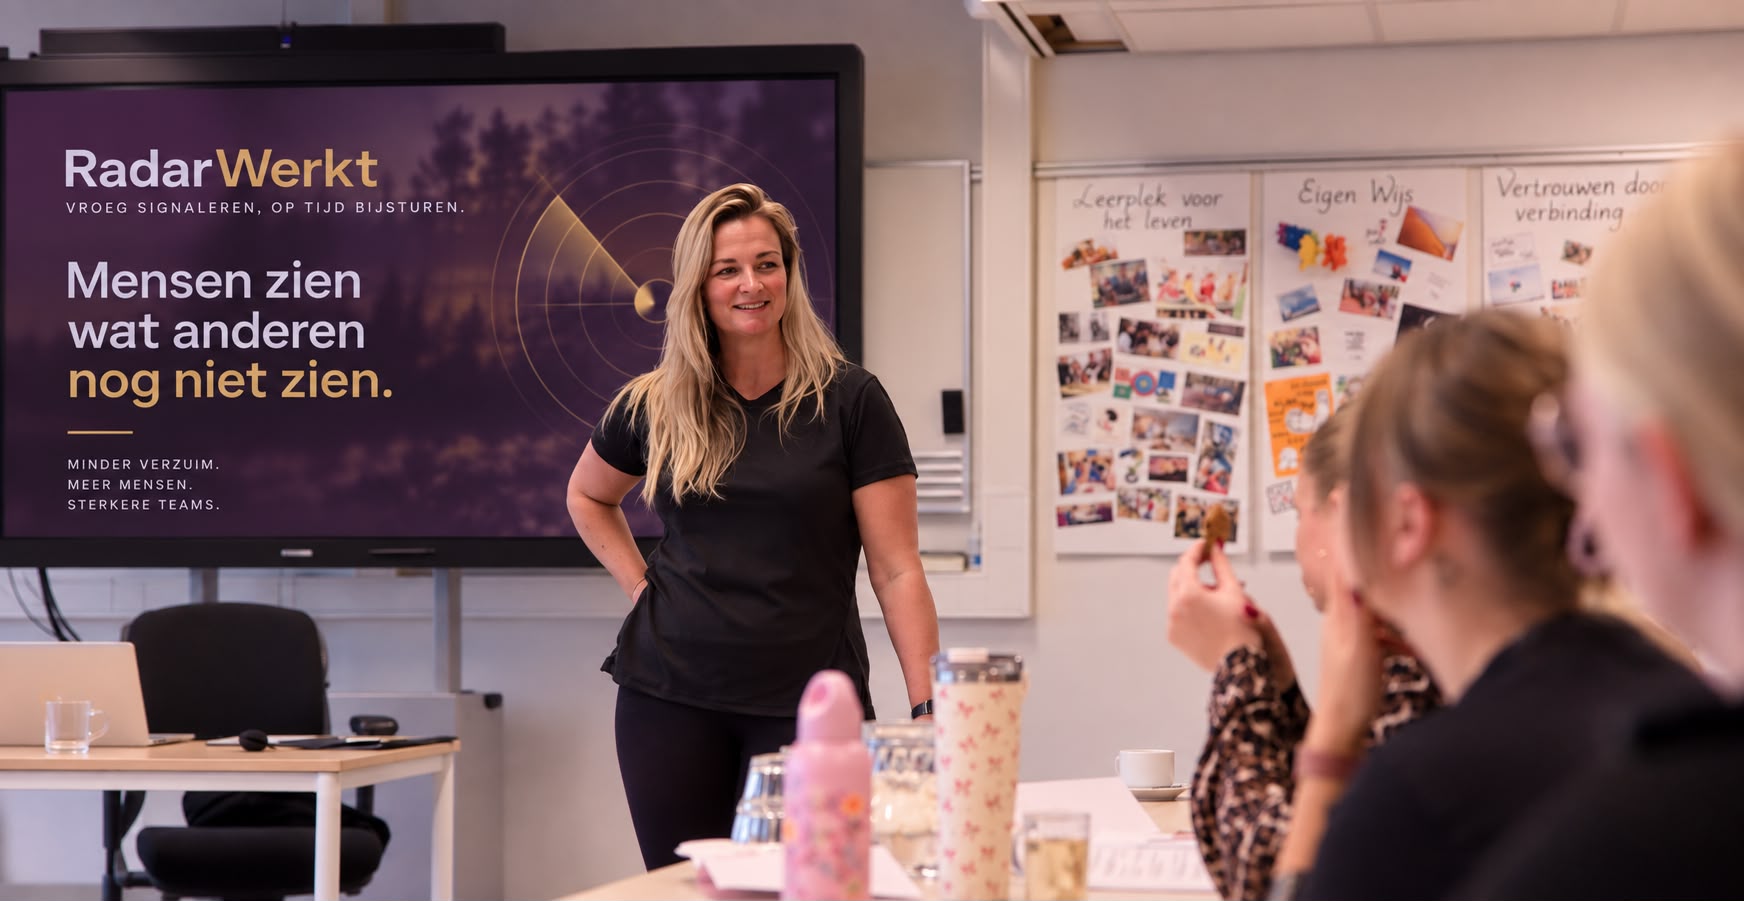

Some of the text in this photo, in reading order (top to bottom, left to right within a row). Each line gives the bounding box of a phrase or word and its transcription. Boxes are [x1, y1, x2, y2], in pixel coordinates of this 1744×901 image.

[65, 148, 378, 188] RadarWerkt
[1497, 167, 1615, 197] Vertrouwen
[66, 201, 465, 216] VROEG SIGNALEREN, OP TIJD BIJSTUREN.
[1073, 184, 1223, 214] Leerplek voor
[1298, 175, 1414, 217] Eigen Wijs
[1103, 210, 1193, 230] het leven
[1515, 200, 1625, 232] verbinding
[67, 259, 362, 299] Mensen zien
[67, 310, 365, 349] wat anderen
[68, 359, 393, 408] nog niet zien.
[67, 459, 220, 470] MINDER VERZUIM.
[67, 479, 193, 490] MEER MENSEN.
[67, 499, 221, 511] STERKERE TEAMS.
